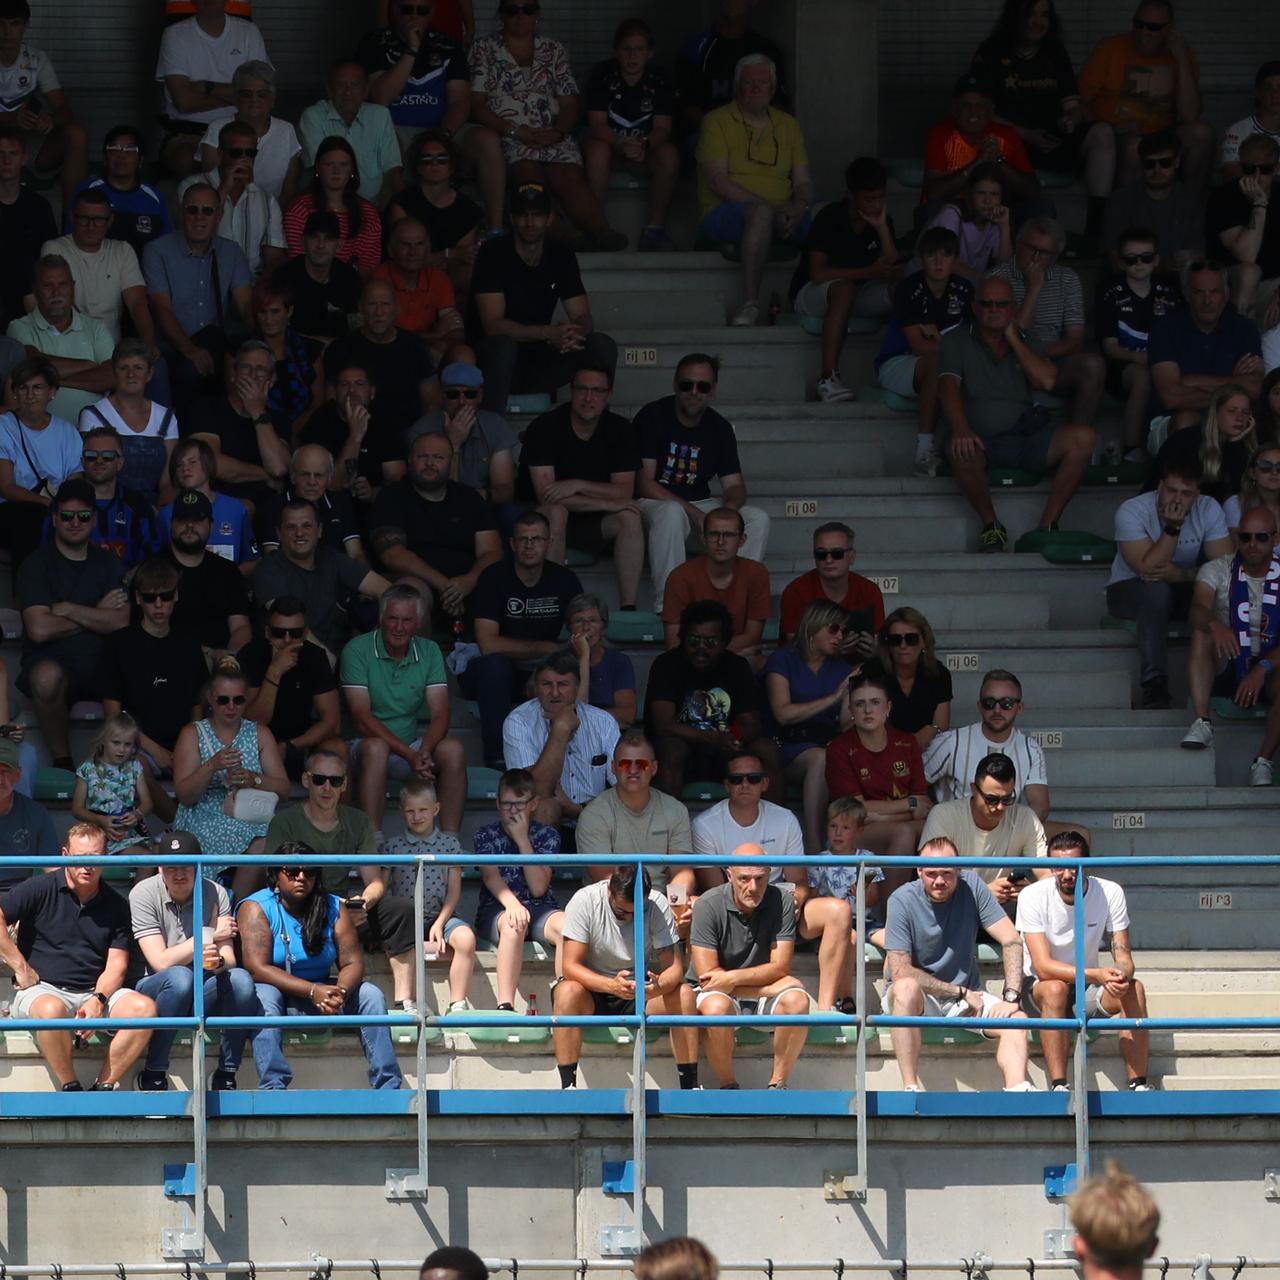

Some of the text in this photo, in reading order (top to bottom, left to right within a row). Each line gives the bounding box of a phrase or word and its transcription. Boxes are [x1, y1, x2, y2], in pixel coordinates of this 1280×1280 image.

[626, 350, 656, 364] rij 10
[786, 502, 816, 515] rij 08
[883, 578, 897, 590] 07
[947, 658, 977, 671] rij 06
[1046, 733, 1061, 744] 05
[1114, 815, 1143, 829] rij 04
[1201, 895, 1212, 908] rij
